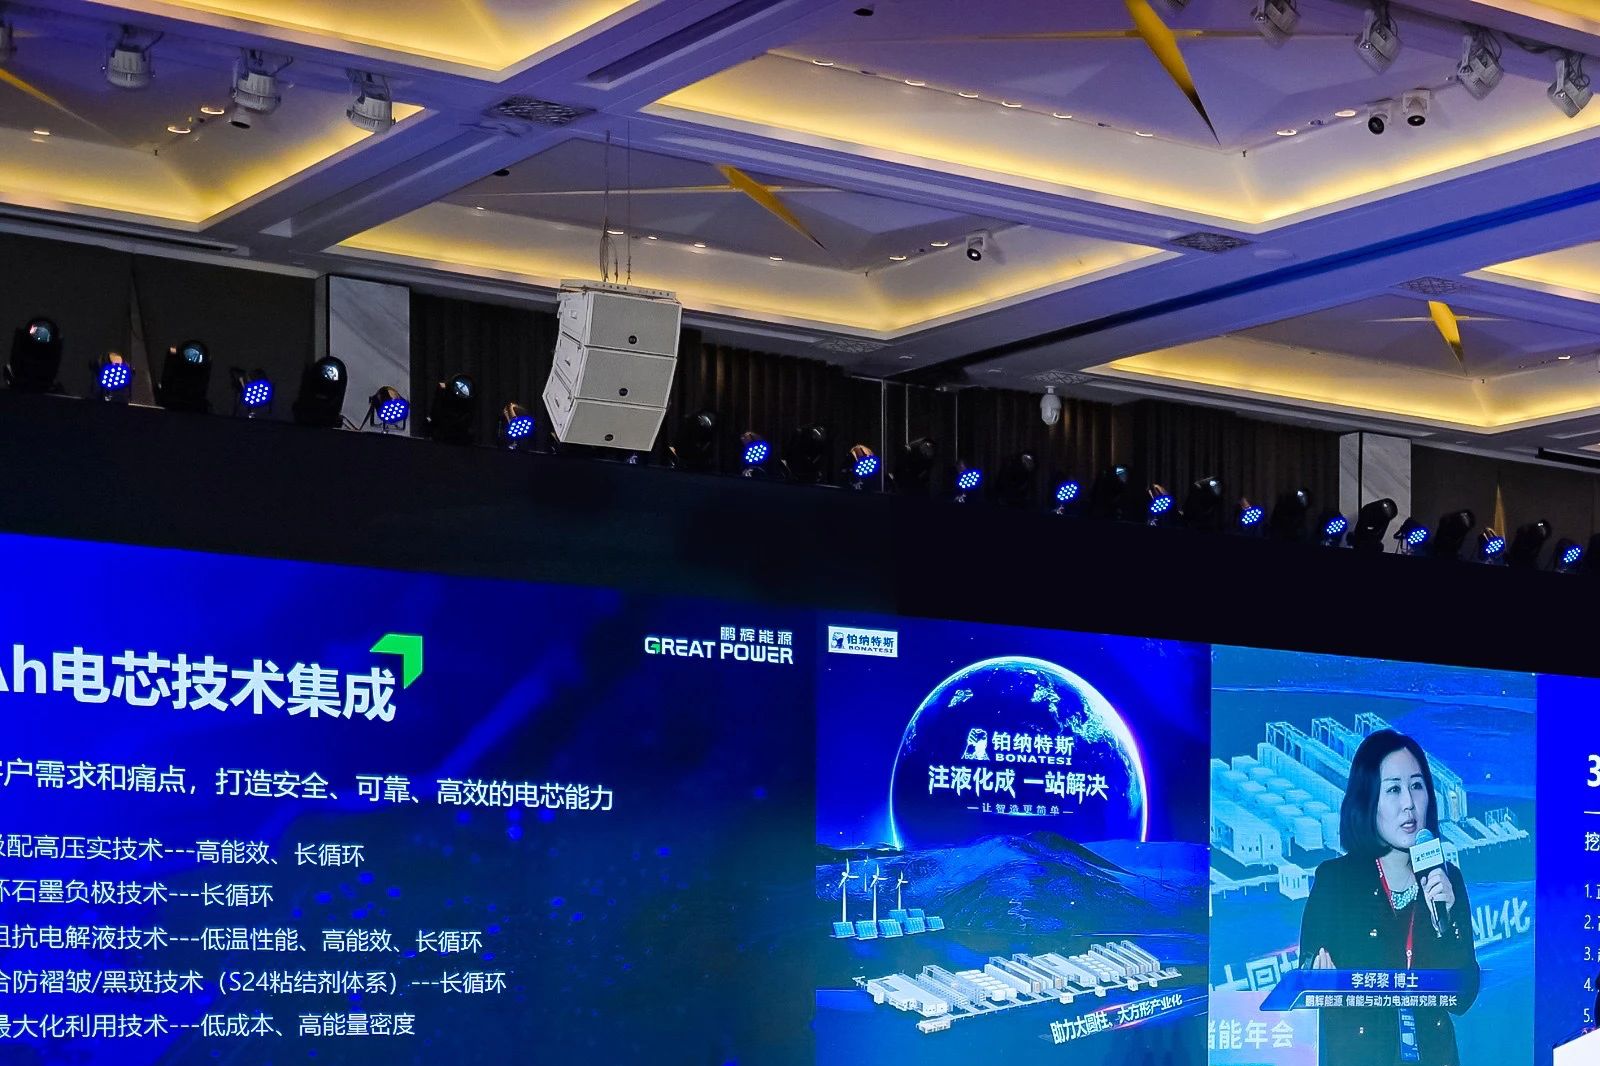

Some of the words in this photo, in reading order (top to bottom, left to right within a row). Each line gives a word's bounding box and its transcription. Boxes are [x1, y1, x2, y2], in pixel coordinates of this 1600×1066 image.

[720, 626, 793, 645] 鹏辉能源
[644, 636, 716, 659] GREAT
[720, 642, 794, 664] POWER
[991, 731, 1075, 756] 铂纳特斯
[995, 753, 1072, 766] BONATESI
[928, 764, 1016, 798] 注液化成
[1023, 770, 1109, 804] 一站解决
[1584, 884, 1593, 899] 1.
[1584, 914, 1594, 931] 2.
[1583, 946, 1594, 961] 3.
[1394, 972, 1419, 989] 博士
[1305, 994, 1343, 1007] 鹏辉能源
[1345, 994, 1437, 1007] 储能与动力电池研究院
[1439, 994, 1457, 1007] 院长
